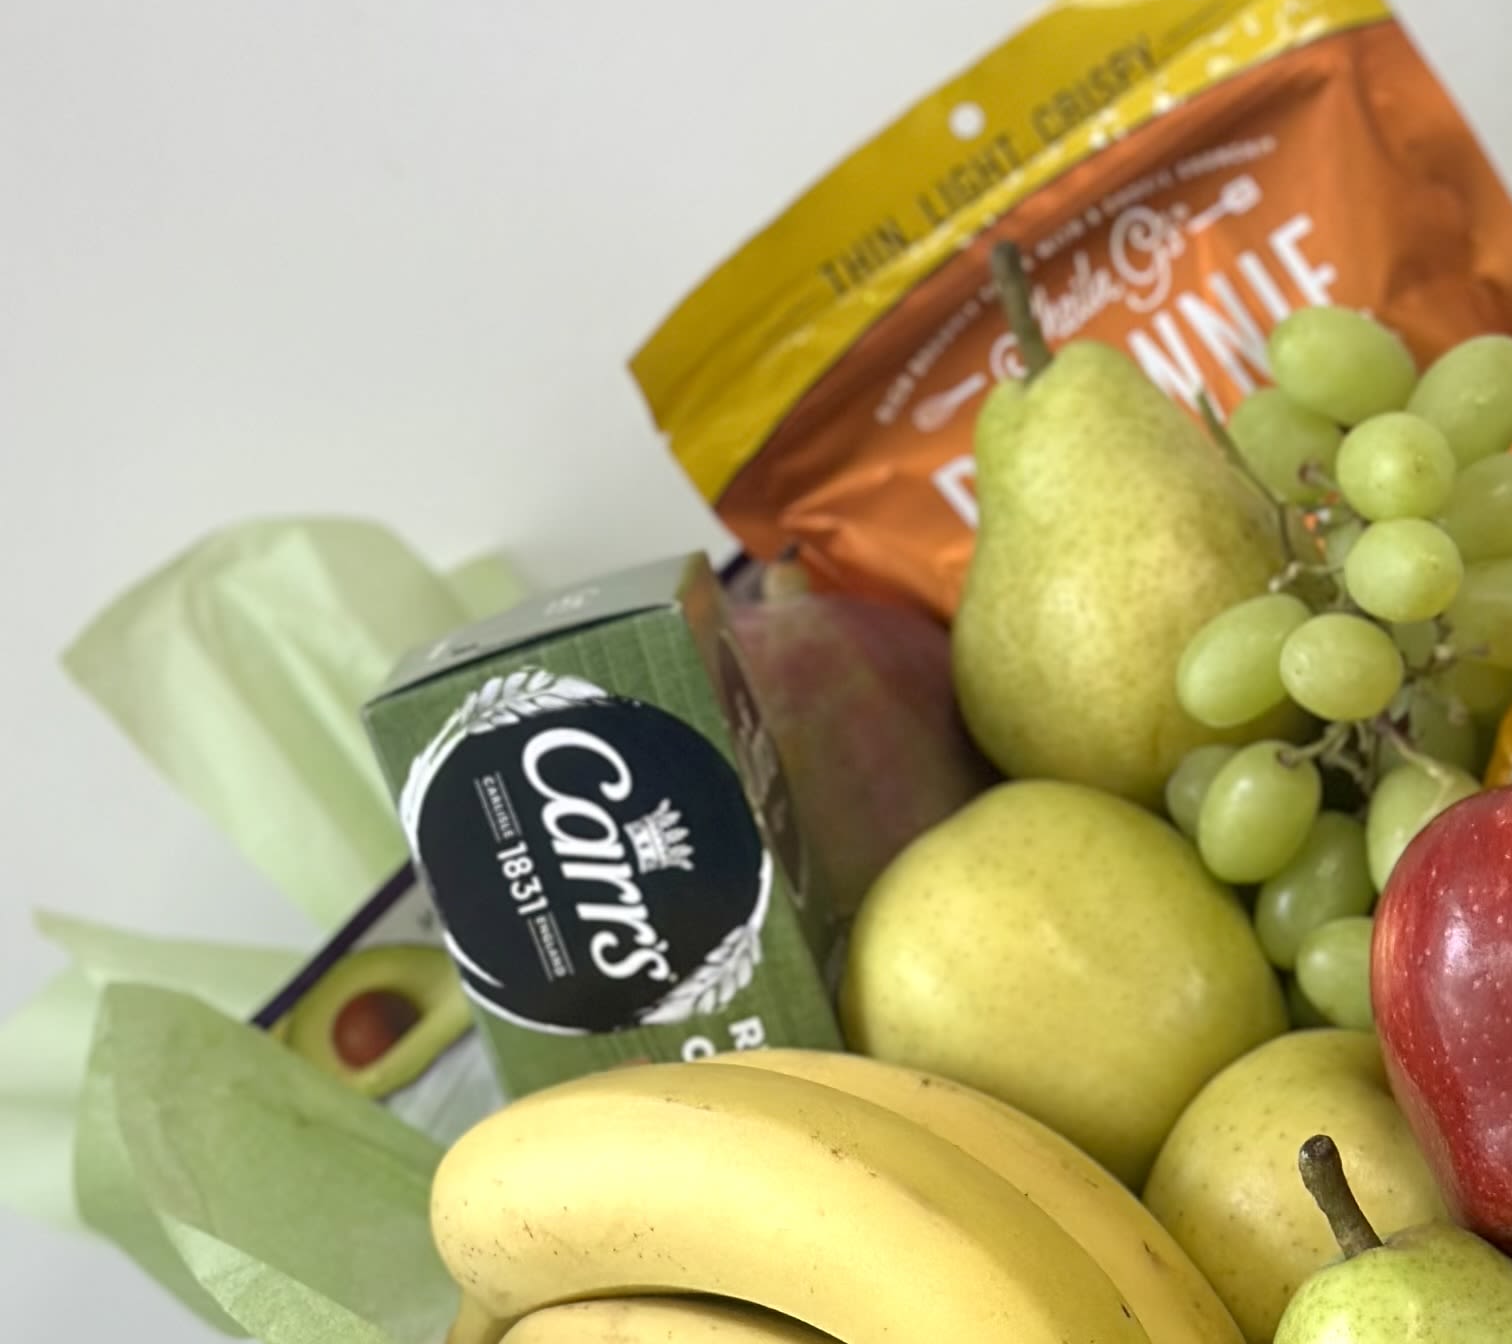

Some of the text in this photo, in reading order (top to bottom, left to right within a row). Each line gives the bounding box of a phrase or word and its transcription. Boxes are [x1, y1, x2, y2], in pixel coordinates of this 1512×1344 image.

[819, 218, 910, 295] THIN
[916, 133, 1021, 227] LIGHT
[1033, 34, 1158, 144] CRISPY
[481, 775, 567, 977] CARLISLE 1831 ENGLAND
[522, 727, 672, 982] Carr's
